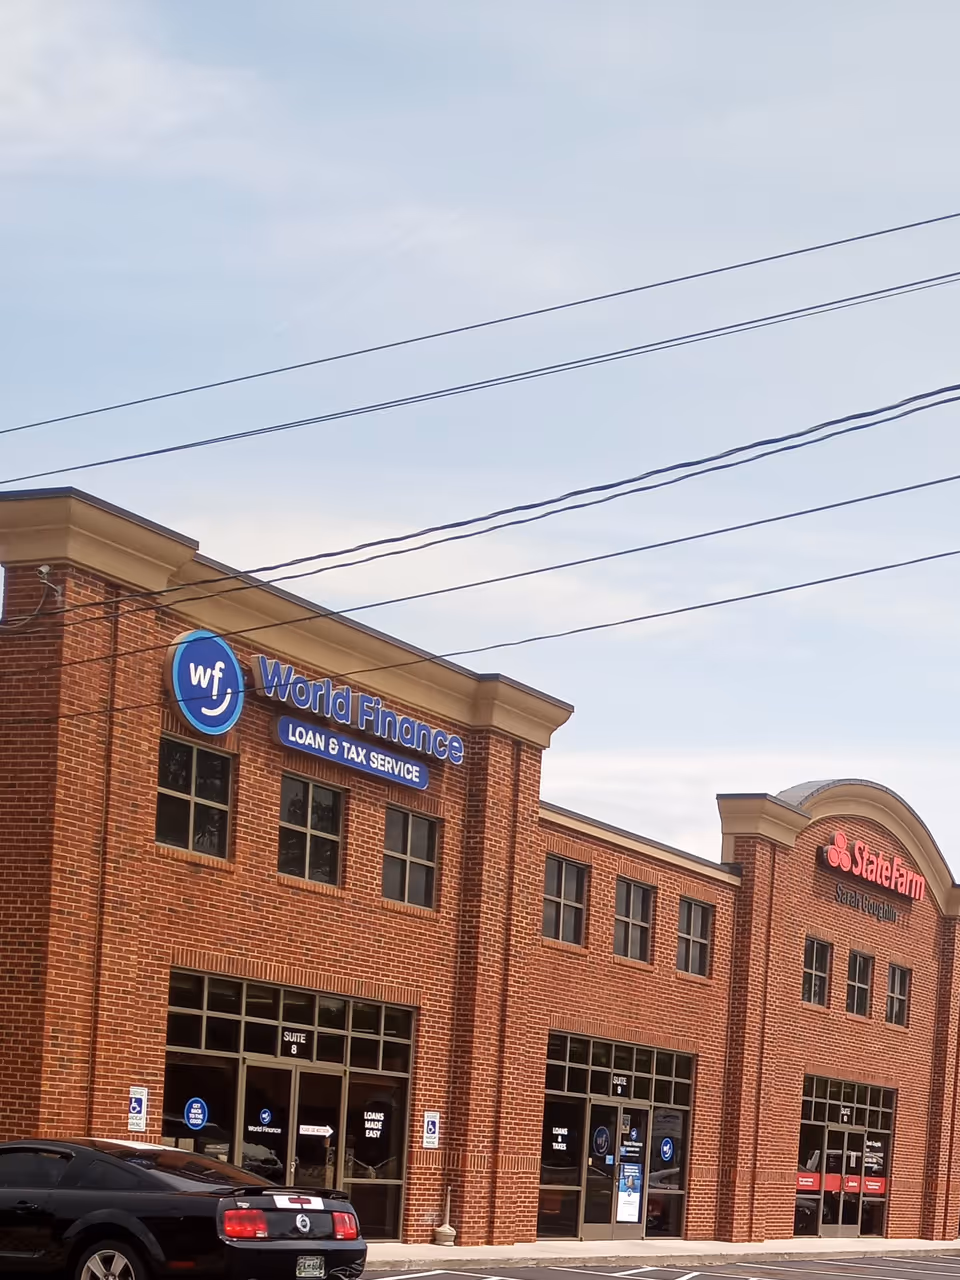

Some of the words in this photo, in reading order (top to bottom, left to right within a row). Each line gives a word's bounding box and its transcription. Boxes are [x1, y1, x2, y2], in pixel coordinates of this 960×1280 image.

[189, 661, 225, 700] wf
[253, 654, 351, 725] World
[357, 692, 465, 765] Finance
[287, 723, 326, 751] LOAN
[328, 738, 340, 755] &
[342, 741, 367, 765] TAX
[369, 753, 420, 782] SERVICE
[283, 1031, 306, 1043] SUITE
[291, 1044, 297, 1054] 8
[612, 1076, 627, 1086] SUITE
[364, 1111, 385, 1121] LOANS
[262, 1126, 282, 1134] Finance
[364, 1120, 383, 1130] MADE
[365, 1129, 382, 1138] EASY
[552, 1127, 569, 1136] LOANS
[552, 1142, 567, 1151] TAXES
